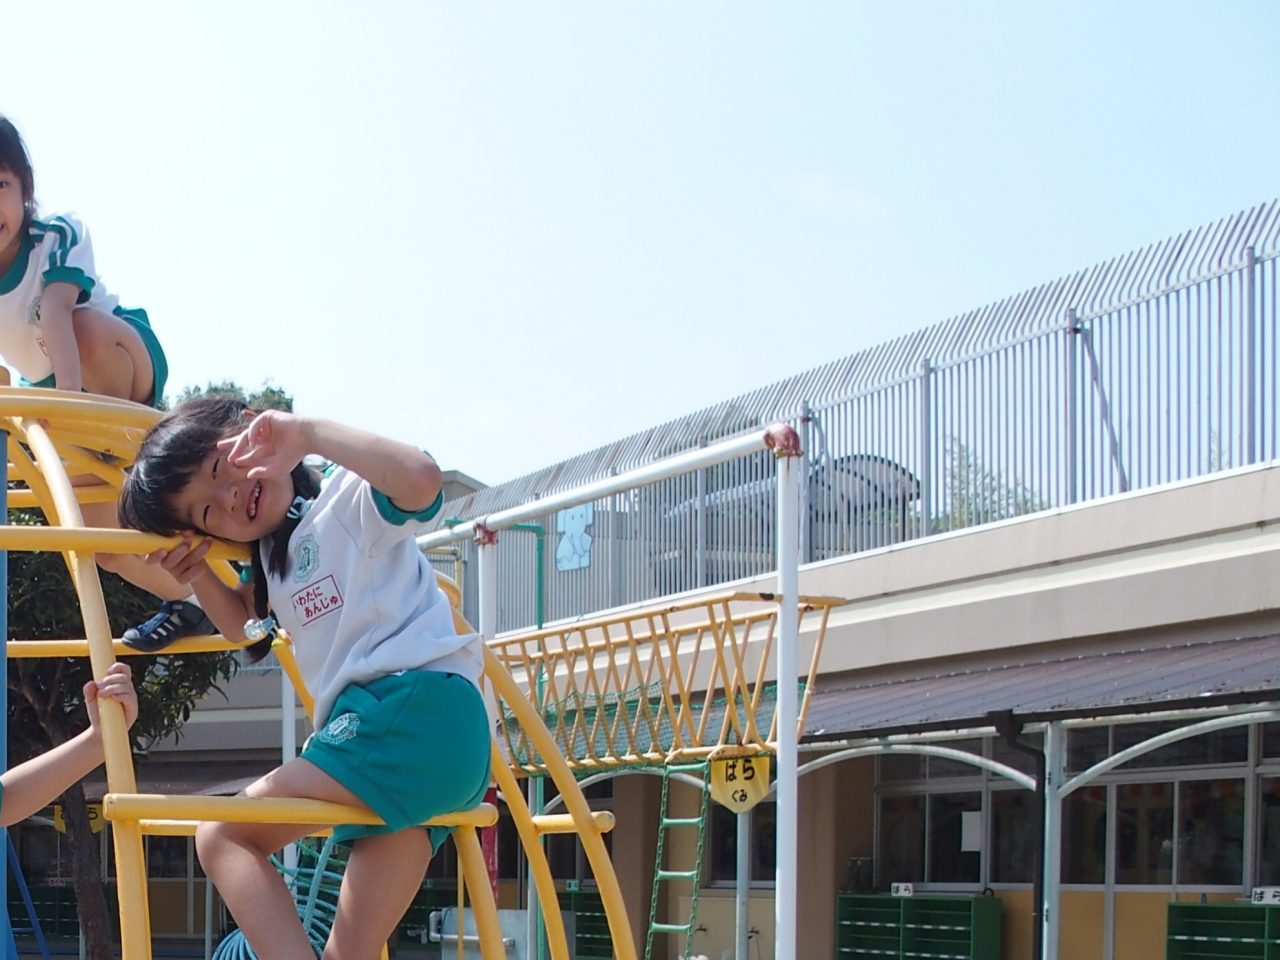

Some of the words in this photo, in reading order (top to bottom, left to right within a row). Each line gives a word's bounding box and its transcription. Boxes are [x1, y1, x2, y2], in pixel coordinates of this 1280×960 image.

[293, 586, 323, 609] いわたに
[725, 757, 755, 783] ばら
